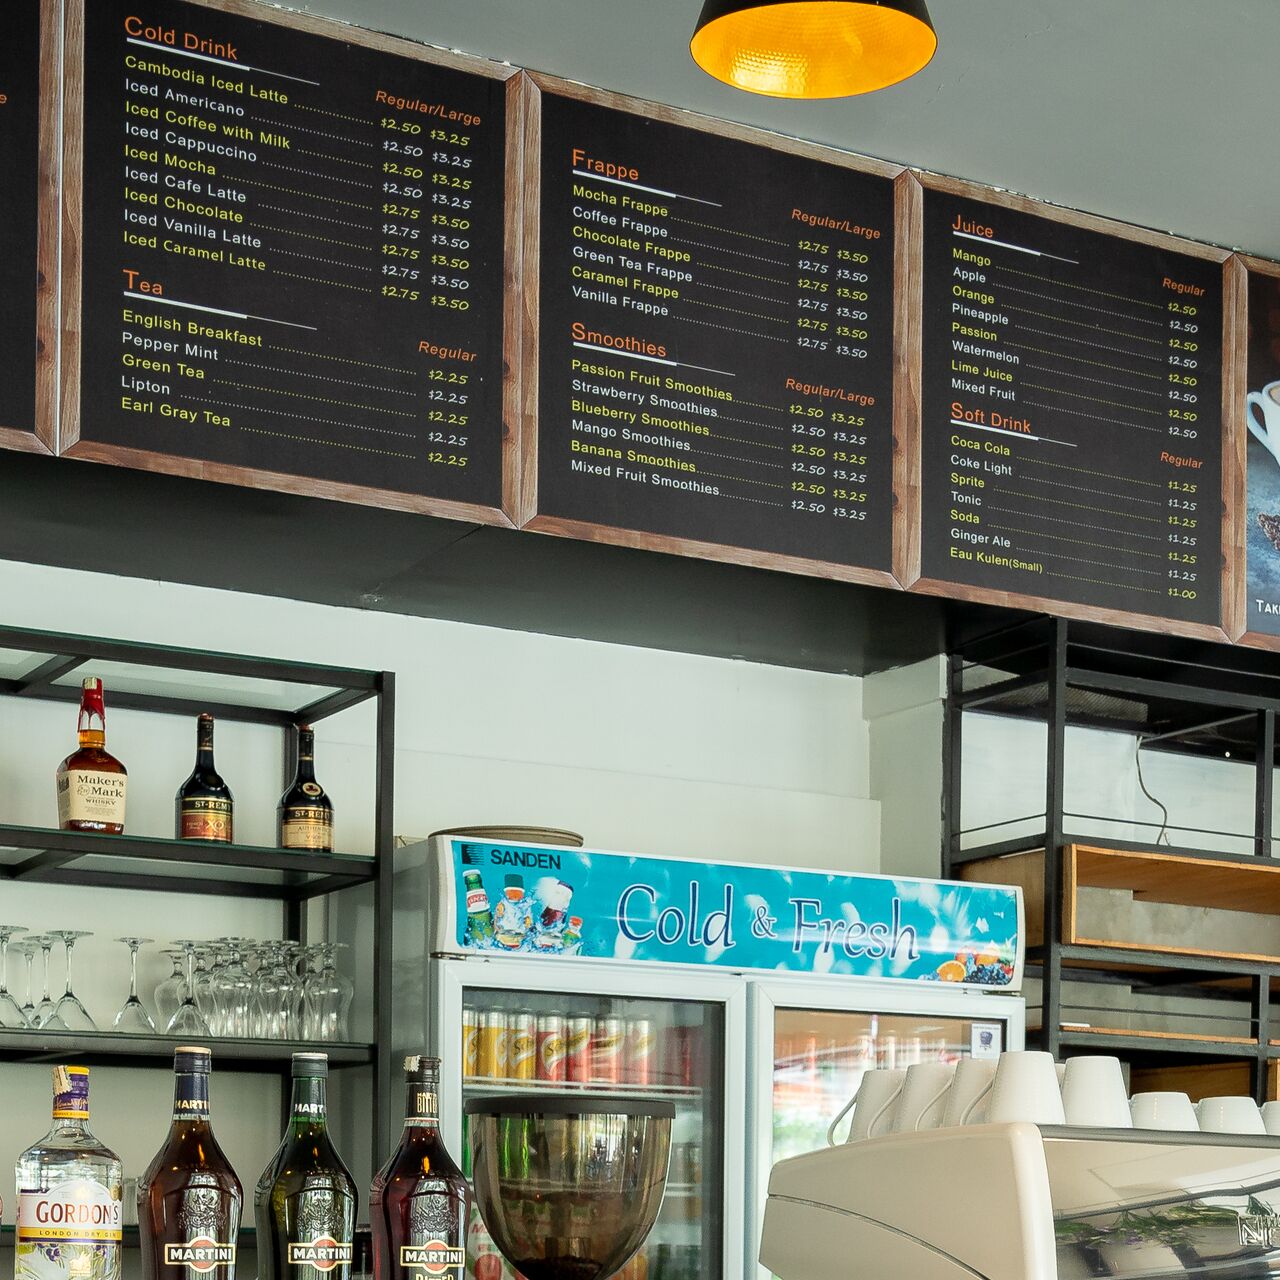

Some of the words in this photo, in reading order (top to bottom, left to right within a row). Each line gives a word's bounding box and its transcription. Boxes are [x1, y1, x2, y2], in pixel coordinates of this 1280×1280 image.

[124, 16, 176, 46] Cold
[183, 31, 238, 61] Drink
[126, 56, 204, 84] Cambodia
[212, 76, 243, 93] Iced
[251, 85, 287, 103] Latte
[381, 118, 420, 134] $2.50
[431, 130, 470, 145] $3.25
[376, 91, 480, 125] Regular/Large
[127, 101, 158, 119] Iced
[166, 111, 216, 132] Coffee
[223, 126, 253, 140] with
[261, 132, 289, 149] Milk
[383, 162, 422, 178] $2.50
[432, 174, 471, 189] $3.25
[126, 122, 158, 140] Iced
[166, 132, 256, 161] Cappuccino
[383, 182, 422, 198] $2.50
[432, 194, 471, 209] $3.25
[573, 149, 638, 180] Frappe
[574, 185, 616, 204] Mocha
[623, 197, 667, 216] Frappe
[797, 240, 829, 254] $2.75
[838, 250, 868, 263] $3.50
[792, 209, 880, 239] Regular/Large
[952, 215, 993, 238] Juice
[123, 269, 162, 295] Tea
[573, 246, 613, 264] Green
[619, 256, 641, 270] Tea
[648, 262, 692, 282] Frappe
[798, 299, 828, 311] $2.75
[837, 308, 867, 320] $3.50
[1163, 277, 1206, 297] Regular
[124, 310, 180, 331] English
[188, 322, 261, 346] Breakfast
[429, 370, 468, 384] $2.25
[419, 341, 476, 361] Regular
[572, 322, 666, 357] Smoothies
[953, 303, 1008, 324] Pineapple
[1168, 356, 1197, 368] $2.50
[952, 340, 1019, 364] Watermelon
[1169, 391, 1197, 403] $2.50
[572, 360, 624, 379] Passion
[631, 371, 660, 386] Fruit
[666, 378, 732, 401] Smoothies
[790, 405, 823, 417] $2.50
[831, 413, 865, 426] $3.25
[786, 379, 874, 406] Regular/Large
[952, 360, 978, 374] Lime
[983, 367, 1012, 382] Juice
[1169, 410, 1197, 421] $2.50
[122, 376, 169, 394] Lipton
[429, 432, 468, 446] $2.25
[952, 403, 984, 423] Soft
[992, 413, 1030, 433] Drink
[122, 397, 152, 413] Earl
[160, 405, 198, 424] Gray
[204, 411, 231, 427] Tea
[428, 452, 467, 466] $2.25
[1161, 452, 1202, 468] Regular
[951, 529, 989, 545] Ginger
[992, 536, 1011, 548] Ale
[1168, 570, 1197, 581] $1.25
[951, 547, 972, 560] Eau
[977, 552, 1042, 574] Kulen(Small)
[1168, 588, 1196, 599] $1.00
[77, 775, 124, 787] Maker's
[92, 786, 123, 798] Mark
[206, 820, 224, 832] XO
[491, 849, 561, 870] SANDEN
[616, 881, 734, 949] Cold
[752, 904, 778, 939] &
[789, 897, 920, 962] Fresh
[36, 1200, 118, 1225] GORDON'S
[170, 1248, 231, 1260] MARTINI
[293, 1247, 351, 1260] MARTINI
[405, 1250, 462, 1263] MARTINI
